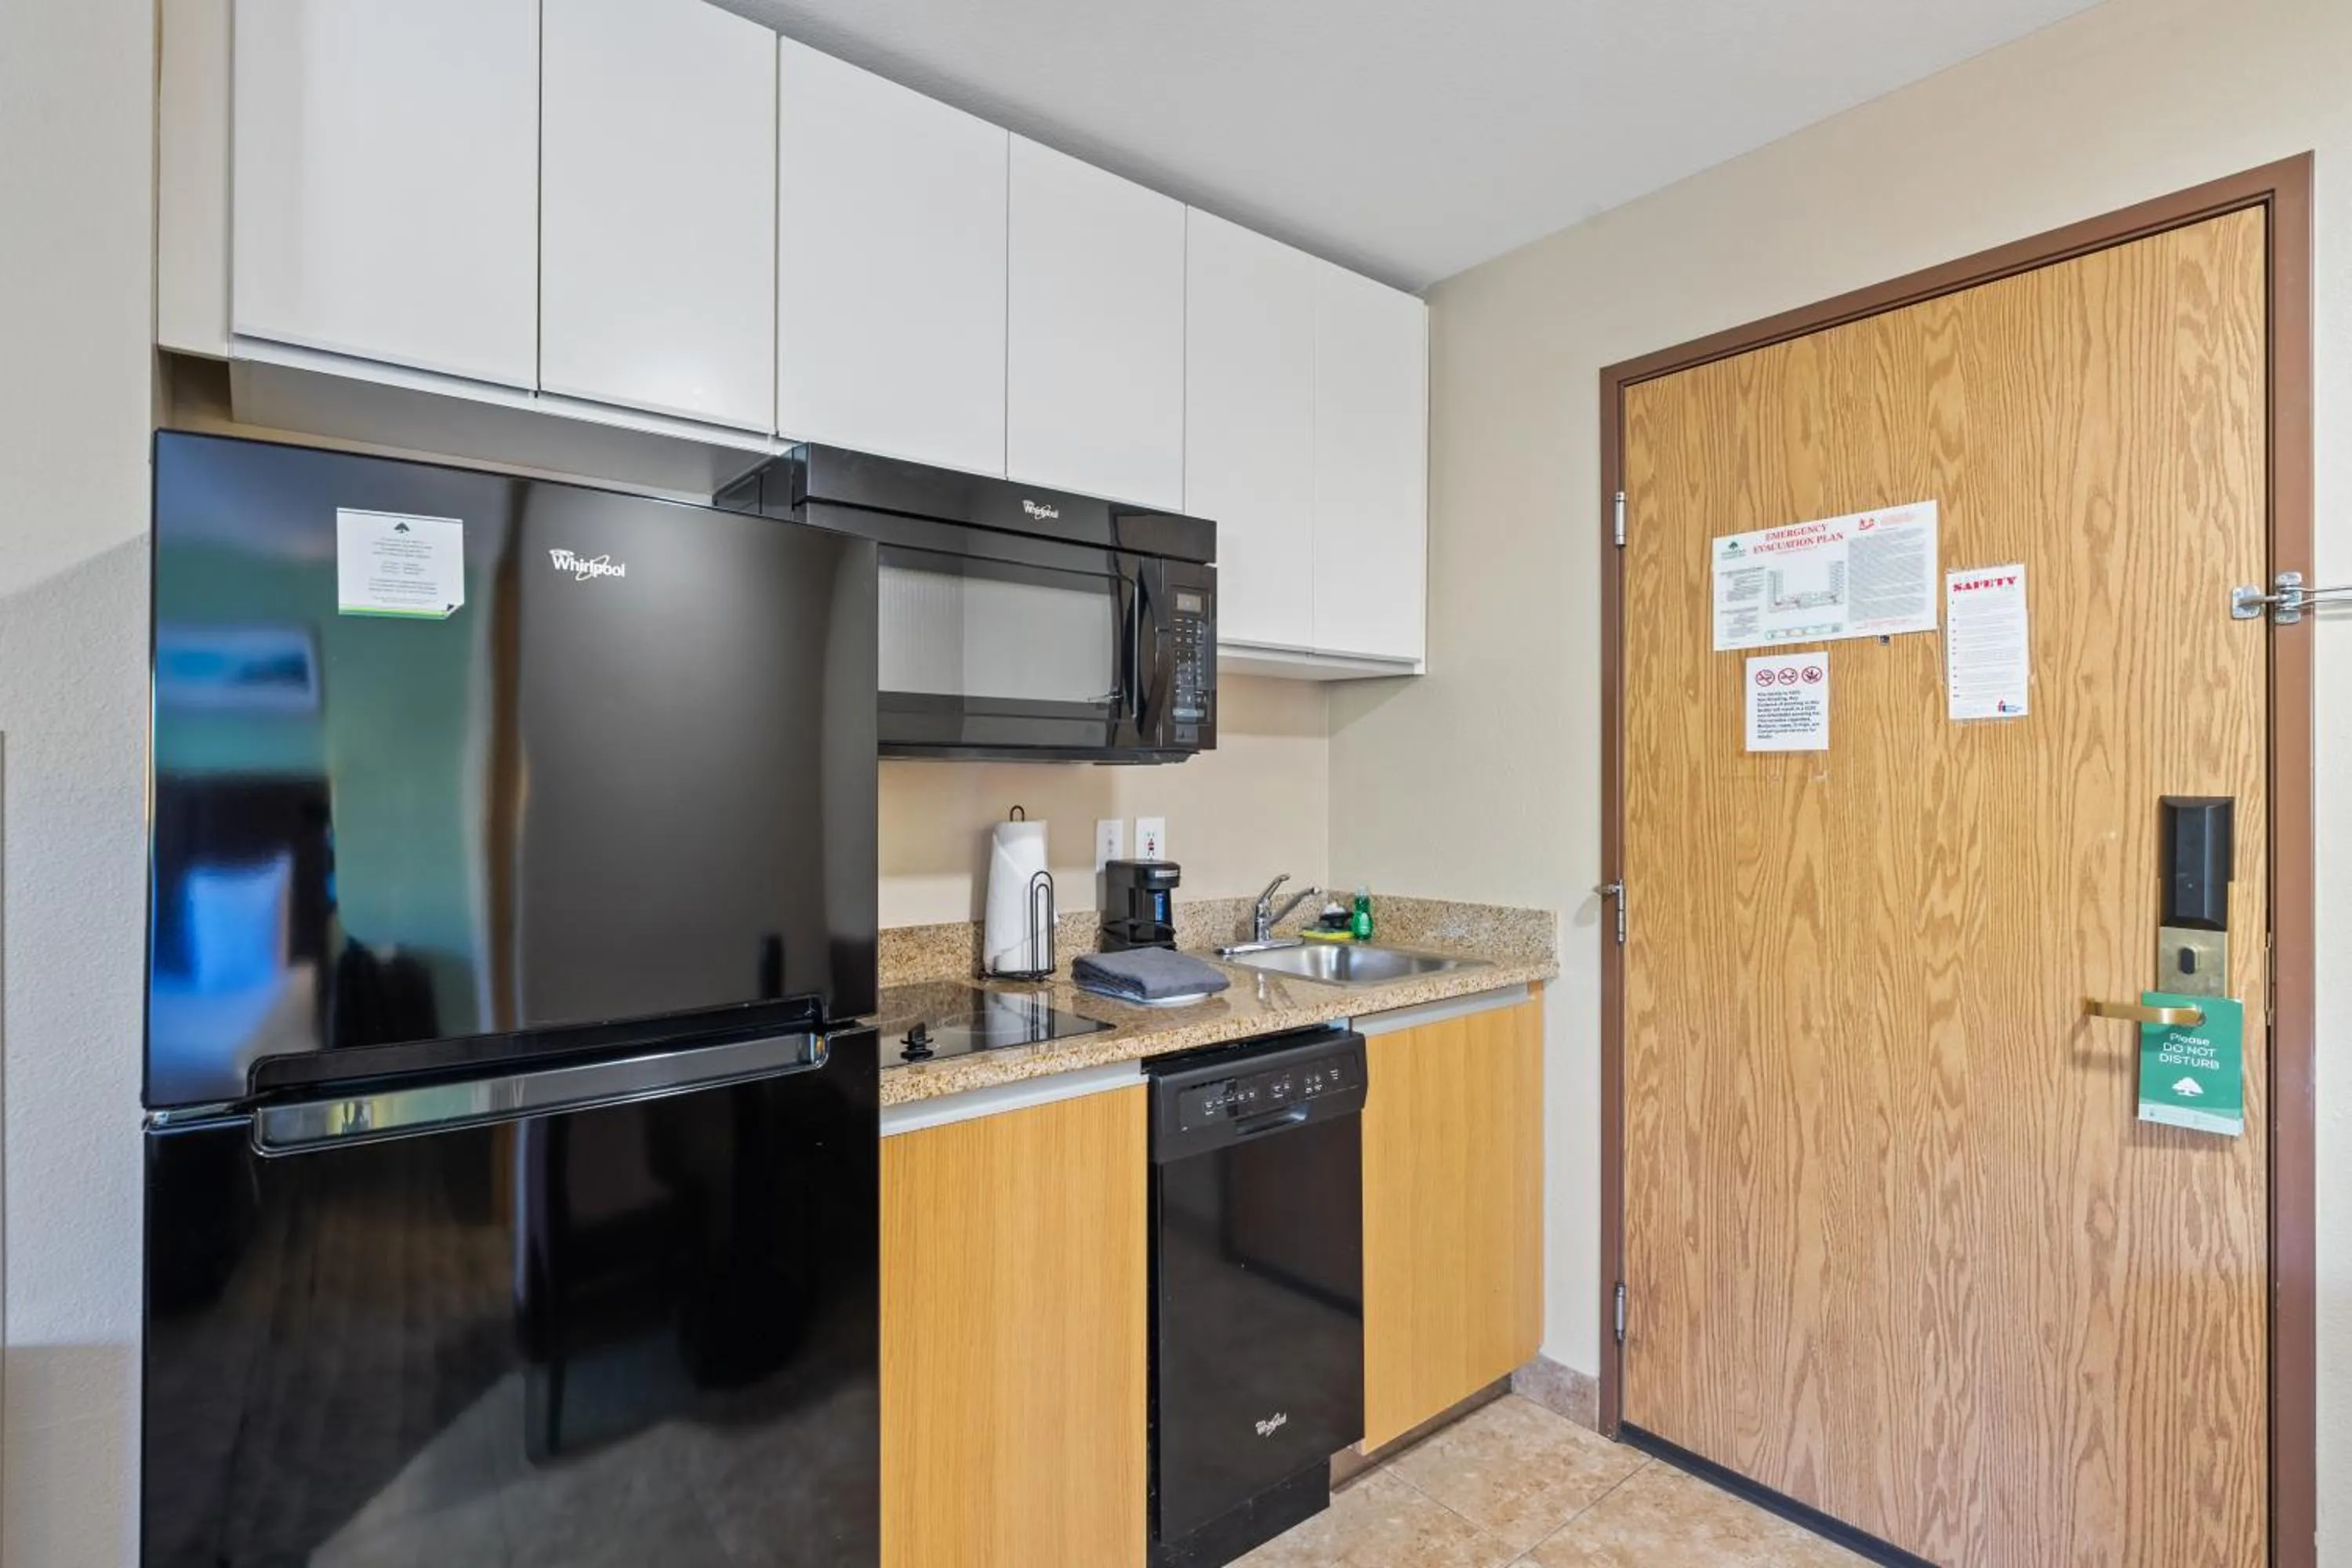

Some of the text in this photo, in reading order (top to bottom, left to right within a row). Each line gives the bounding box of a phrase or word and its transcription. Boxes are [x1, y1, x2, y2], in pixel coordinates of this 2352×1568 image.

[1766, 523, 1828, 541] EMERGENCY
[1753, 536, 1815, 554] EVACUATION
[1817, 532, 1844, 545] PLAN
[550, 549, 625, 580] Whirlpool
[1953, 575, 2017, 592] SAFETY
[2169, 1033, 2210, 1047] Please
[2163, 1042, 2217, 1058] DO NOT
[2158, 1052, 2220, 1070] DISTURB
